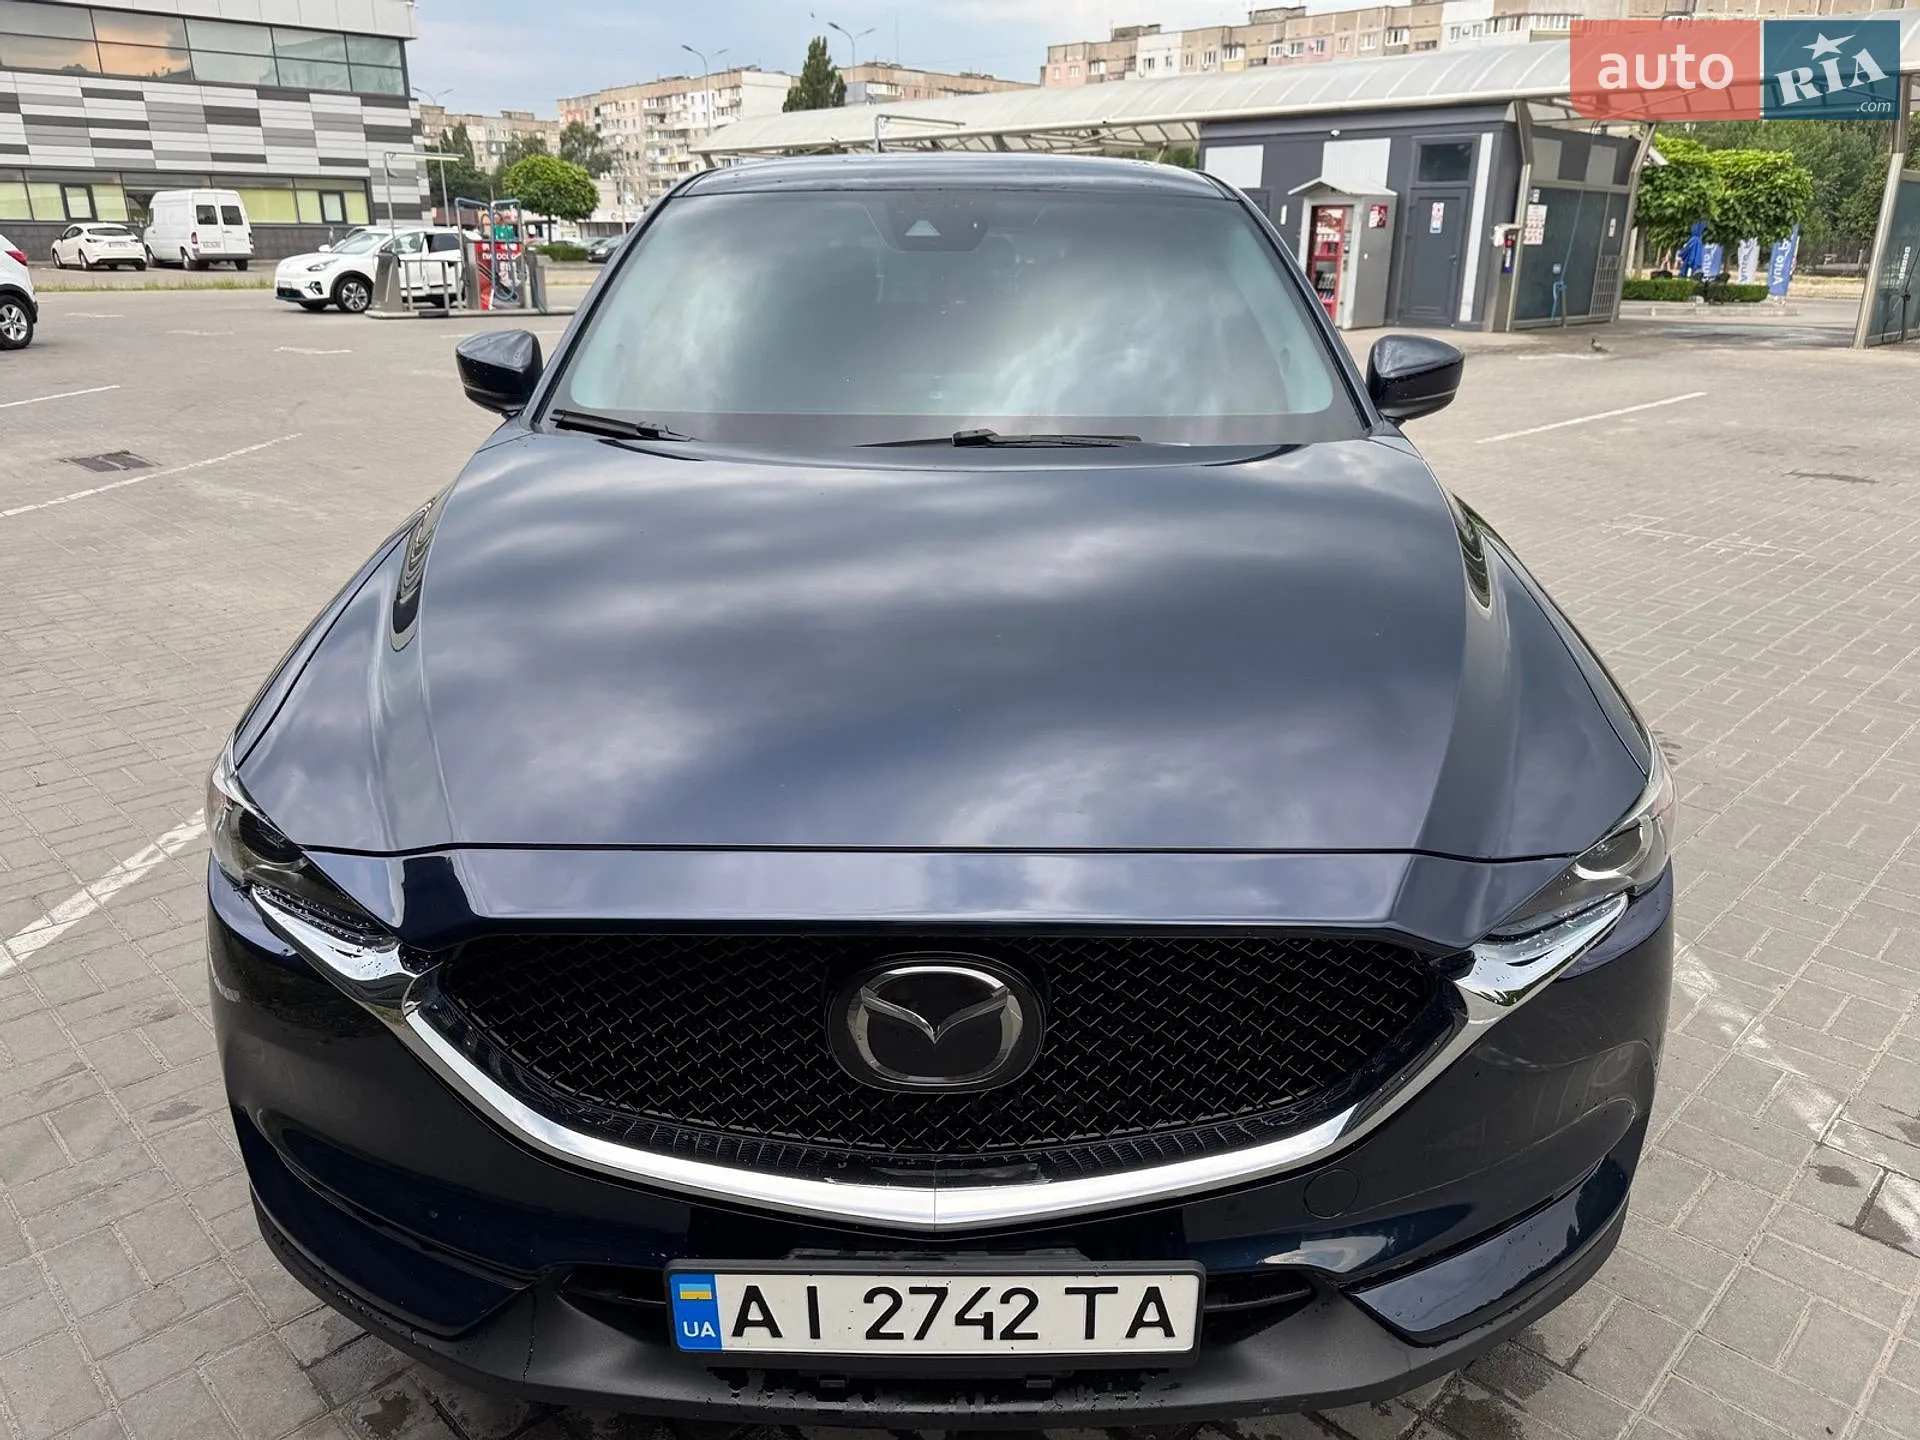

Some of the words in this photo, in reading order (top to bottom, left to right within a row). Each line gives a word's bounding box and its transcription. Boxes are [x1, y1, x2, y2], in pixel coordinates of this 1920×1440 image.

[683, 1321, 716, 1338] UA
[731, 1285, 820, 1339] AI
[863, 1286, 1040, 1341] 2742
[1064, 1285, 1176, 1339] TA
